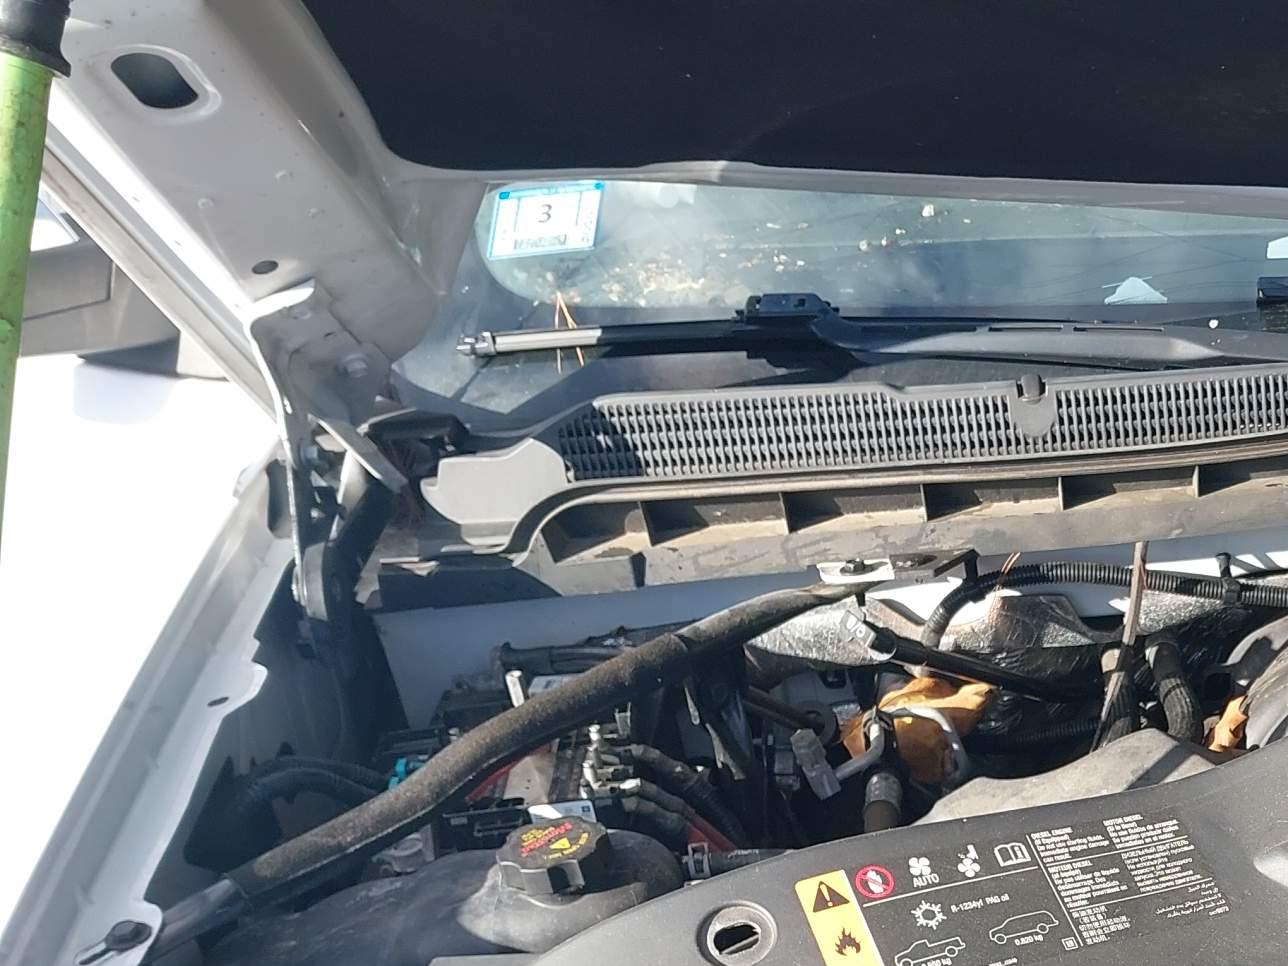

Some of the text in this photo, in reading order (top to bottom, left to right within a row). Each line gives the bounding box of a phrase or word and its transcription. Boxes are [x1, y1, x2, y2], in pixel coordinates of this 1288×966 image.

[537, 204, 553, 224] 3
[913, 873, 940, 888] AUTO
[985, 896, 1000, 904] PAG
